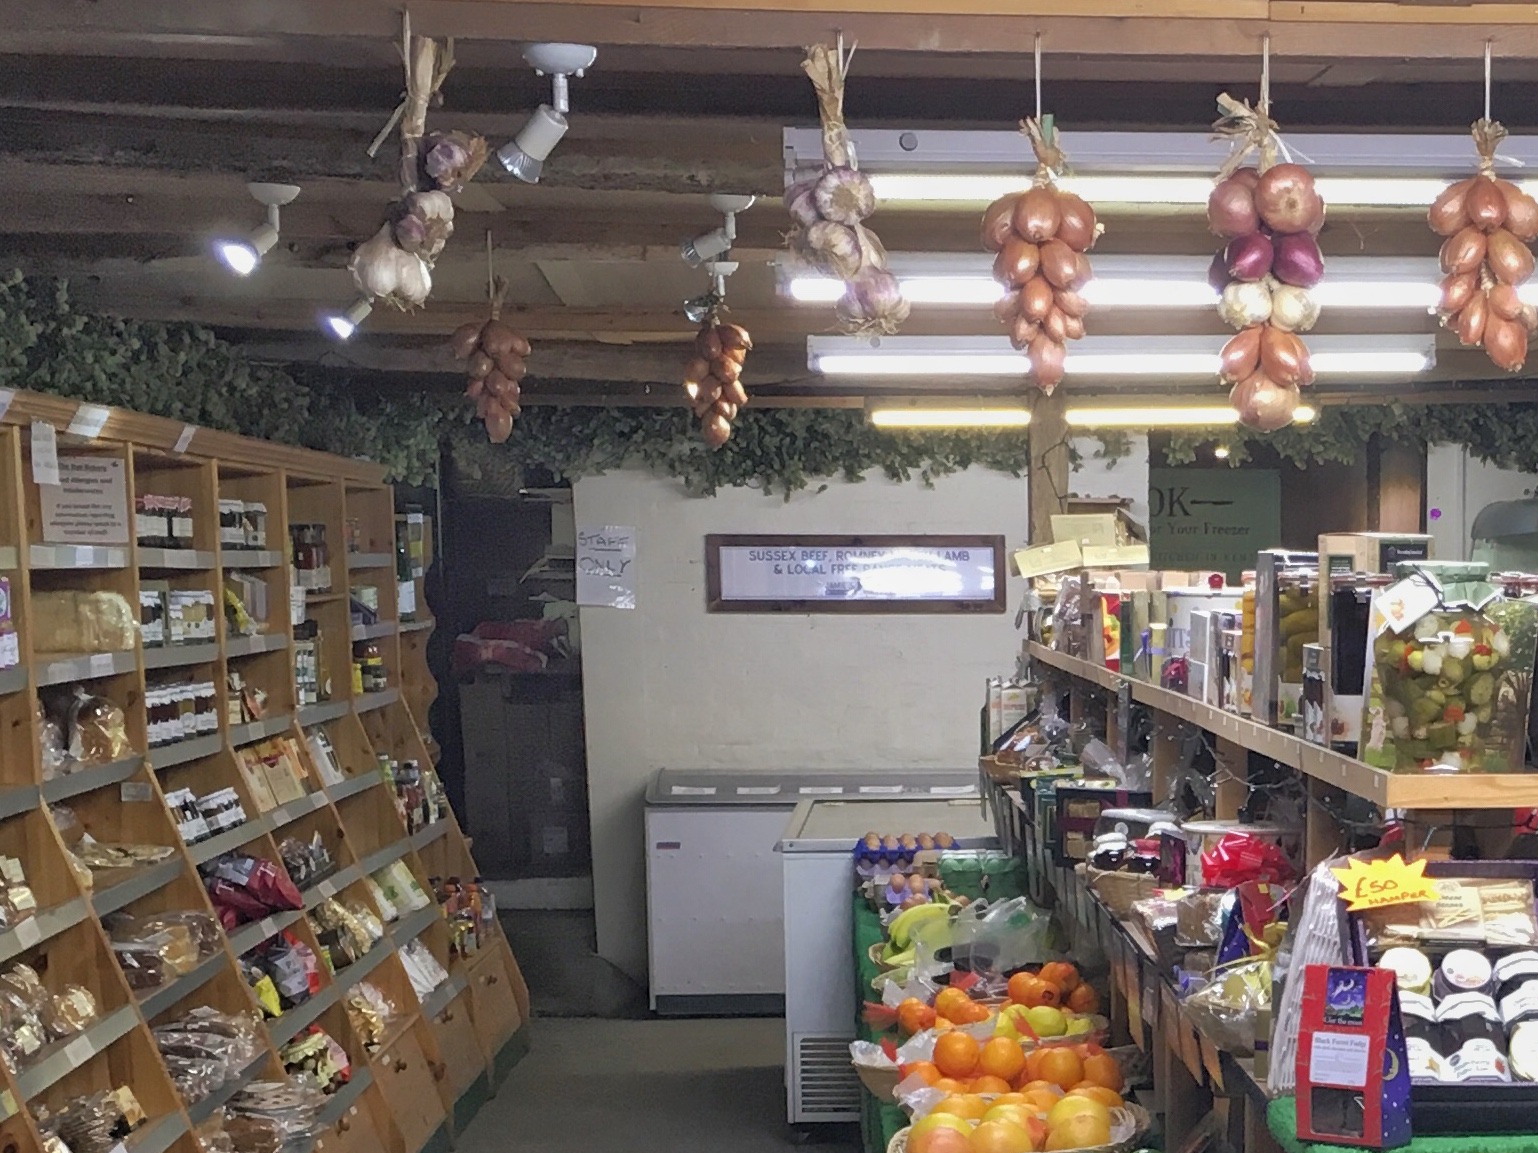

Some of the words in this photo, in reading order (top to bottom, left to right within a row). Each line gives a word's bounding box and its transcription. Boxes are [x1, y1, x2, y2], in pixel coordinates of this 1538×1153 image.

[1168, 523, 1198, 535] Your
[1204, 522, 1250, 535] Freezer
[749, 550, 796, 562] SUSSEX
[578, 556, 631, 573] ONLY
[773, 564, 783, 575] &
[787, 563, 827, 575] LOCAL
[1355, 877, 1399, 899] £50
[1368, 890, 1431, 906] HAMPER
